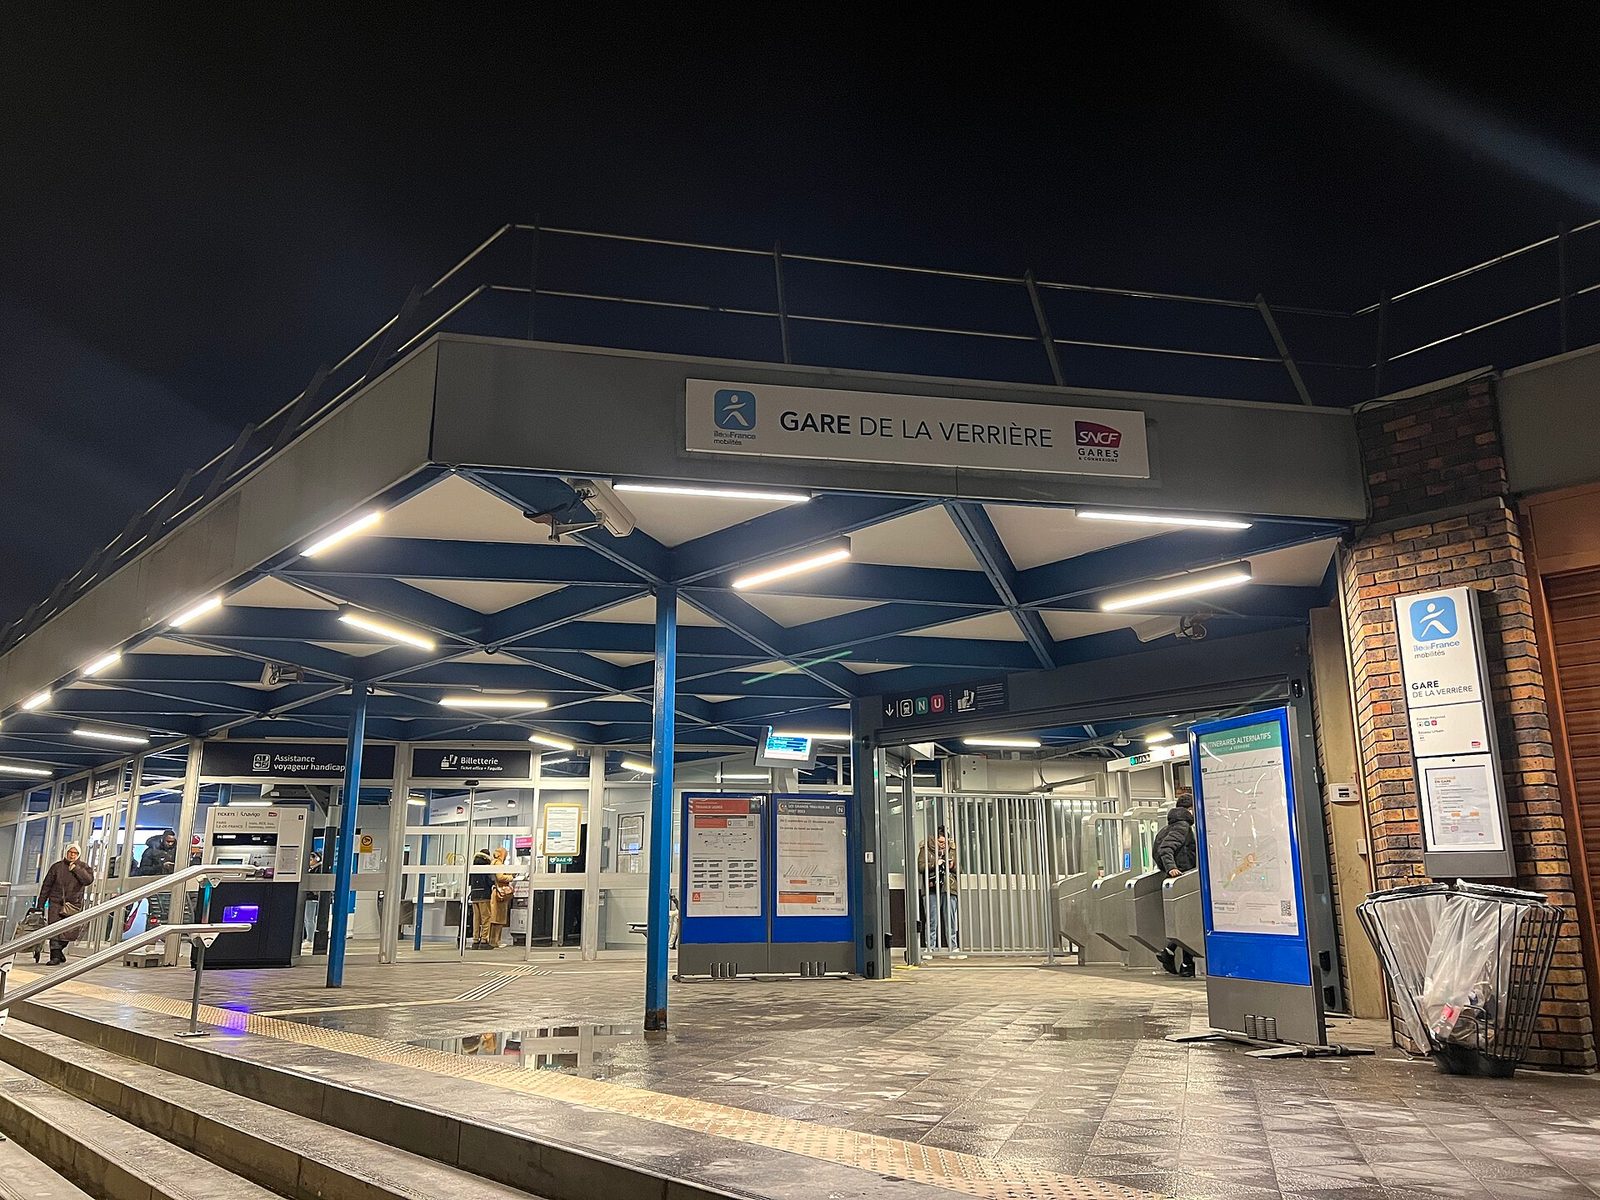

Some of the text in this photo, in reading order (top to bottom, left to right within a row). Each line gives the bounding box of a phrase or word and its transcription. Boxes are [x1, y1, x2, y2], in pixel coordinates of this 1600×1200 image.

[779, 410, 1053, 448] GARE DE LA VERRIÈRE
[713, 438, 743, 446] mobilités
[1077, 431, 1119, 445] SNCF
[1077, 447, 1119, 458] GARES
[1414, 650, 1446, 659] mobilités
[1411, 680, 1440, 690] GARE
[1412, 685, 1473, 699] DE LA VERRIÈRE
[918, 698, 941, 711] N U
[1236, 731, 1271, 744] ALTERNATIFS
[274, 754, 315, 763] Assistance
[460, 756, 499, 765] Billetterie
[273, 763, 346, 773] voyageur handicap
